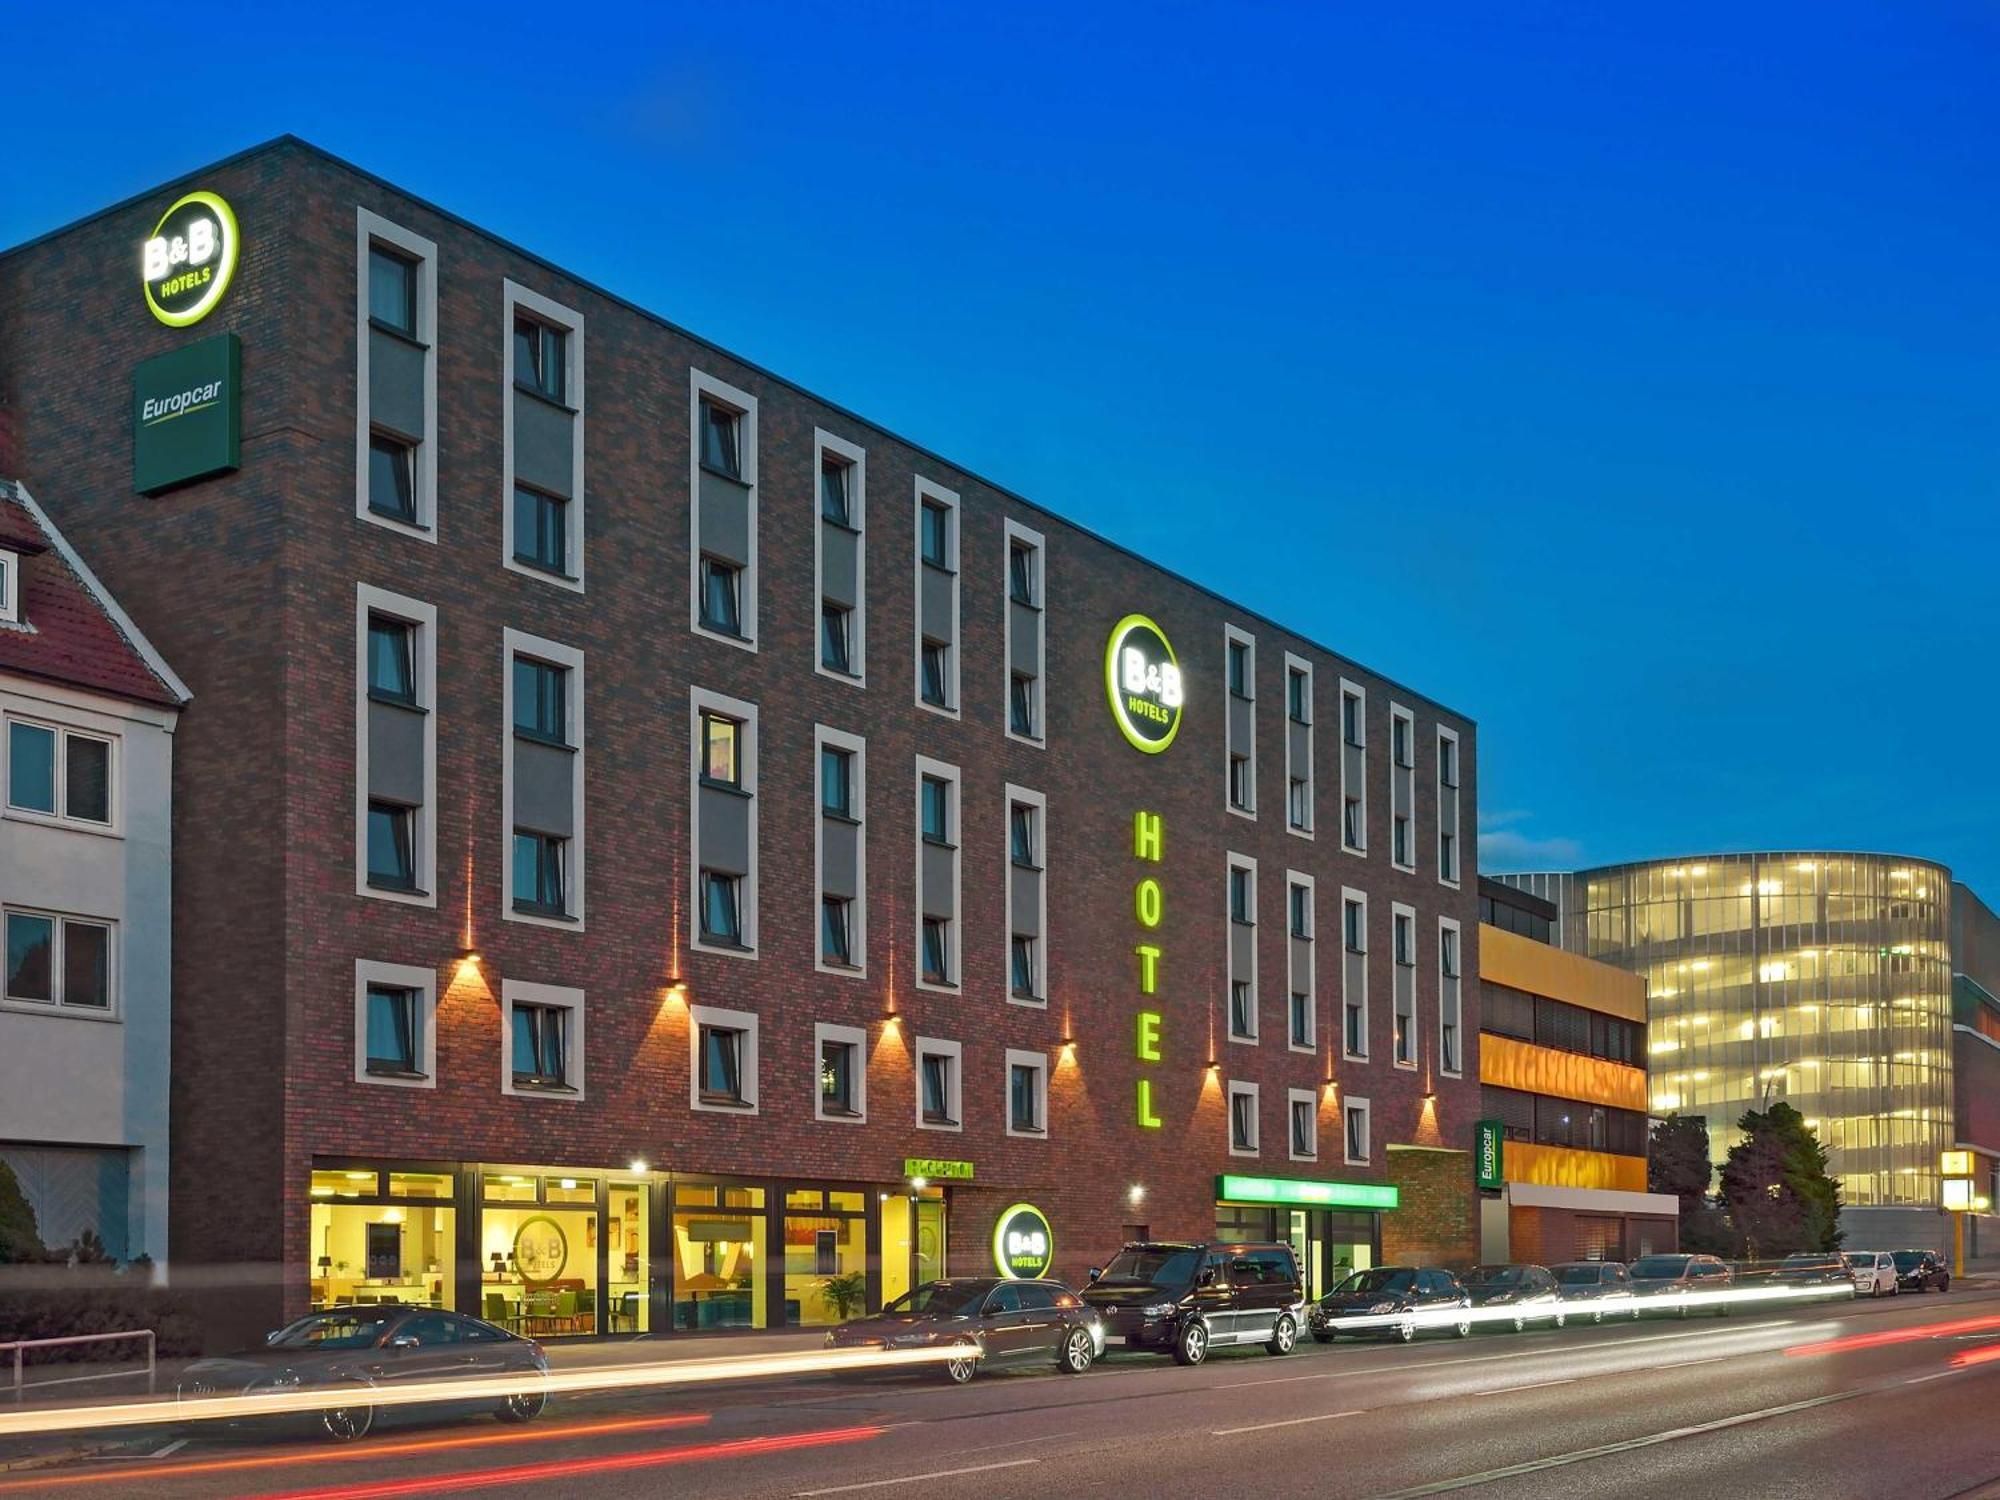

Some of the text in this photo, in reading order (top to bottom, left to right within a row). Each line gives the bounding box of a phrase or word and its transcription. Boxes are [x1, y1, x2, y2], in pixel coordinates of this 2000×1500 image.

[144, 218, 217, 281] B&B
[160, 266, 211, 298] HOTELS
[141, 379, 222, 421] Europcar
[1123, 646, 1184, 708] B&B
[1128, 695, 1169, 725] HOTELS
[1134, 811, 1162, 1128] HOTEL
[1481, 1127, 1495, 1180] Europcar
[521, 1238, 561, 1259] B&B
[1008, 1231, 1046, 1256] B&B
[1011, 1256, 1043, 1268] HOTELS
